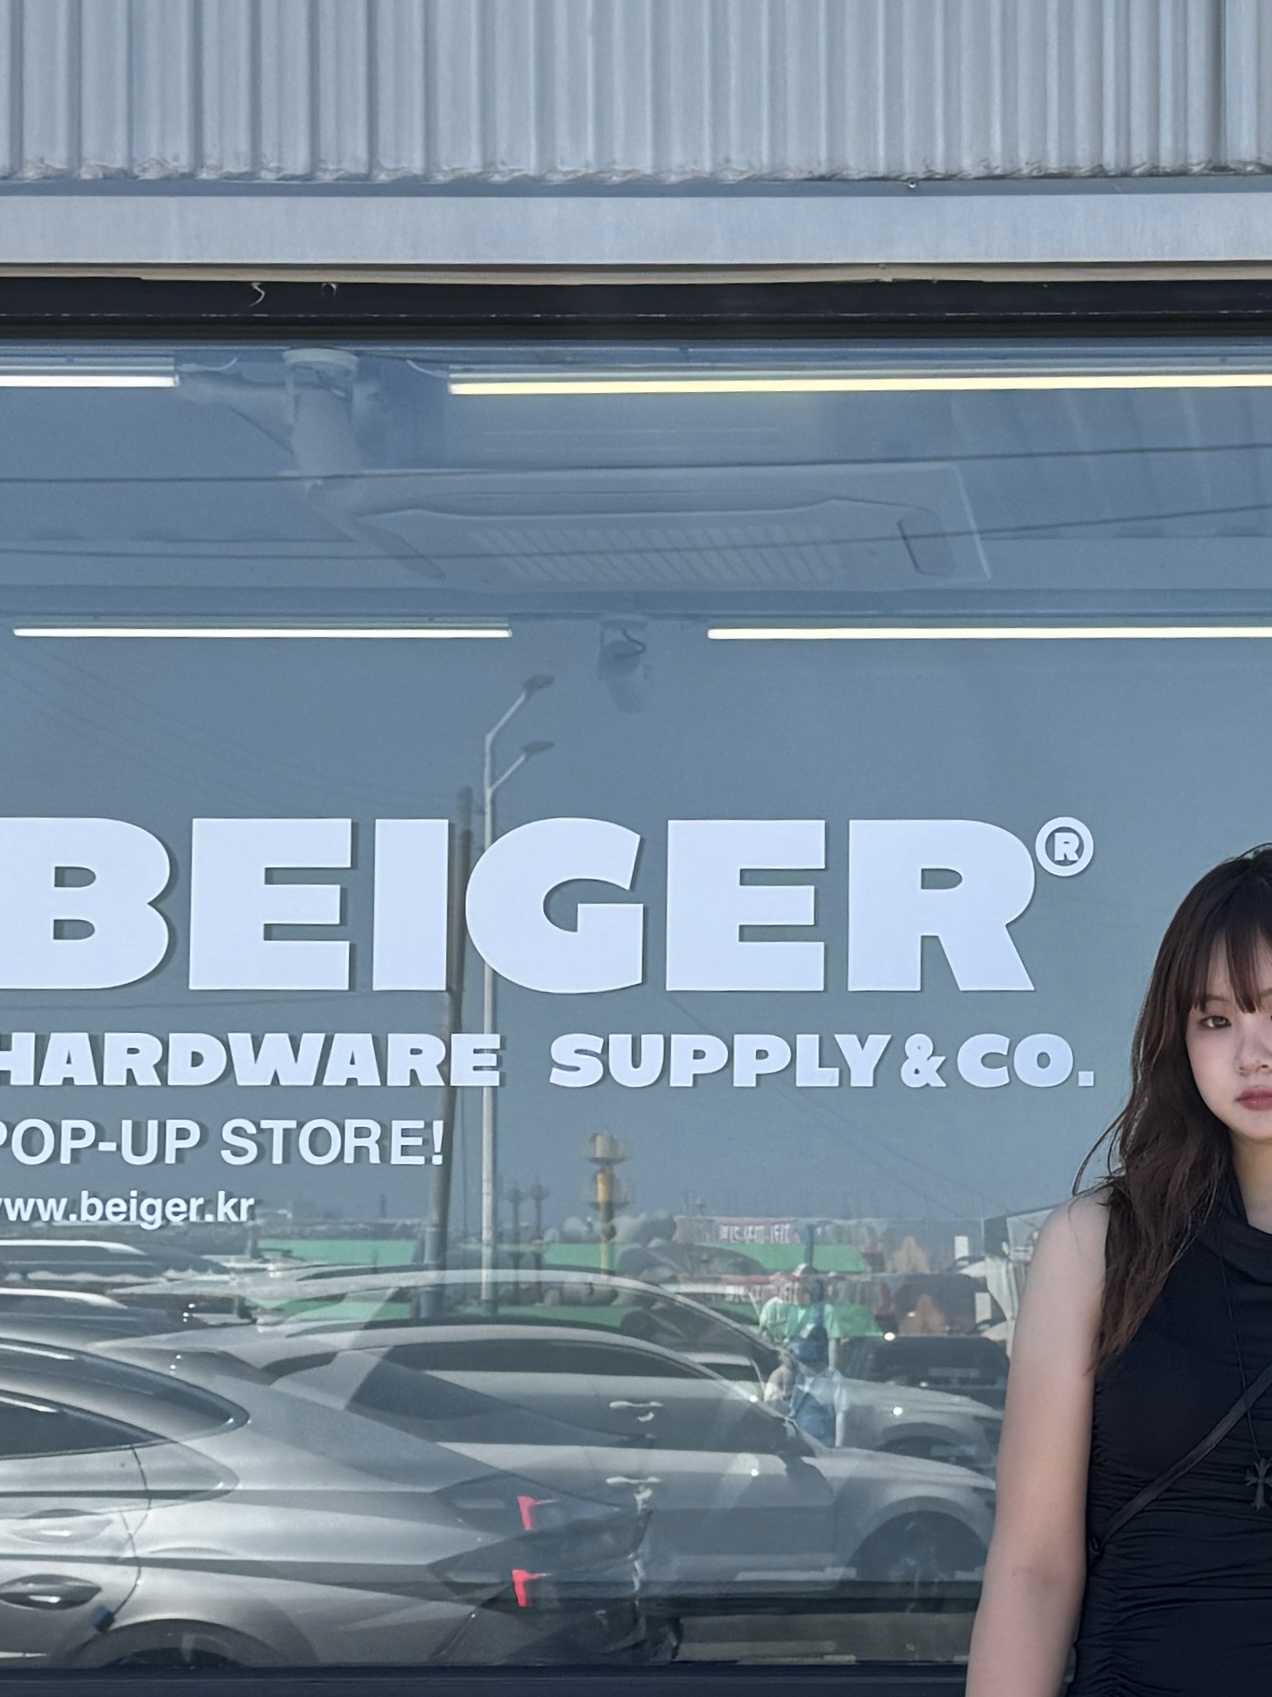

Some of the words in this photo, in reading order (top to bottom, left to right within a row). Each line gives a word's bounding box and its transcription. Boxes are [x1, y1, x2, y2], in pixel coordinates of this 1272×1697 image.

[0, 1117, 202, 1167] OP-UP
[219, 1117, 445, 1167] STORE!
[0, 1188, 256, 1231] ww.beiger.kr
